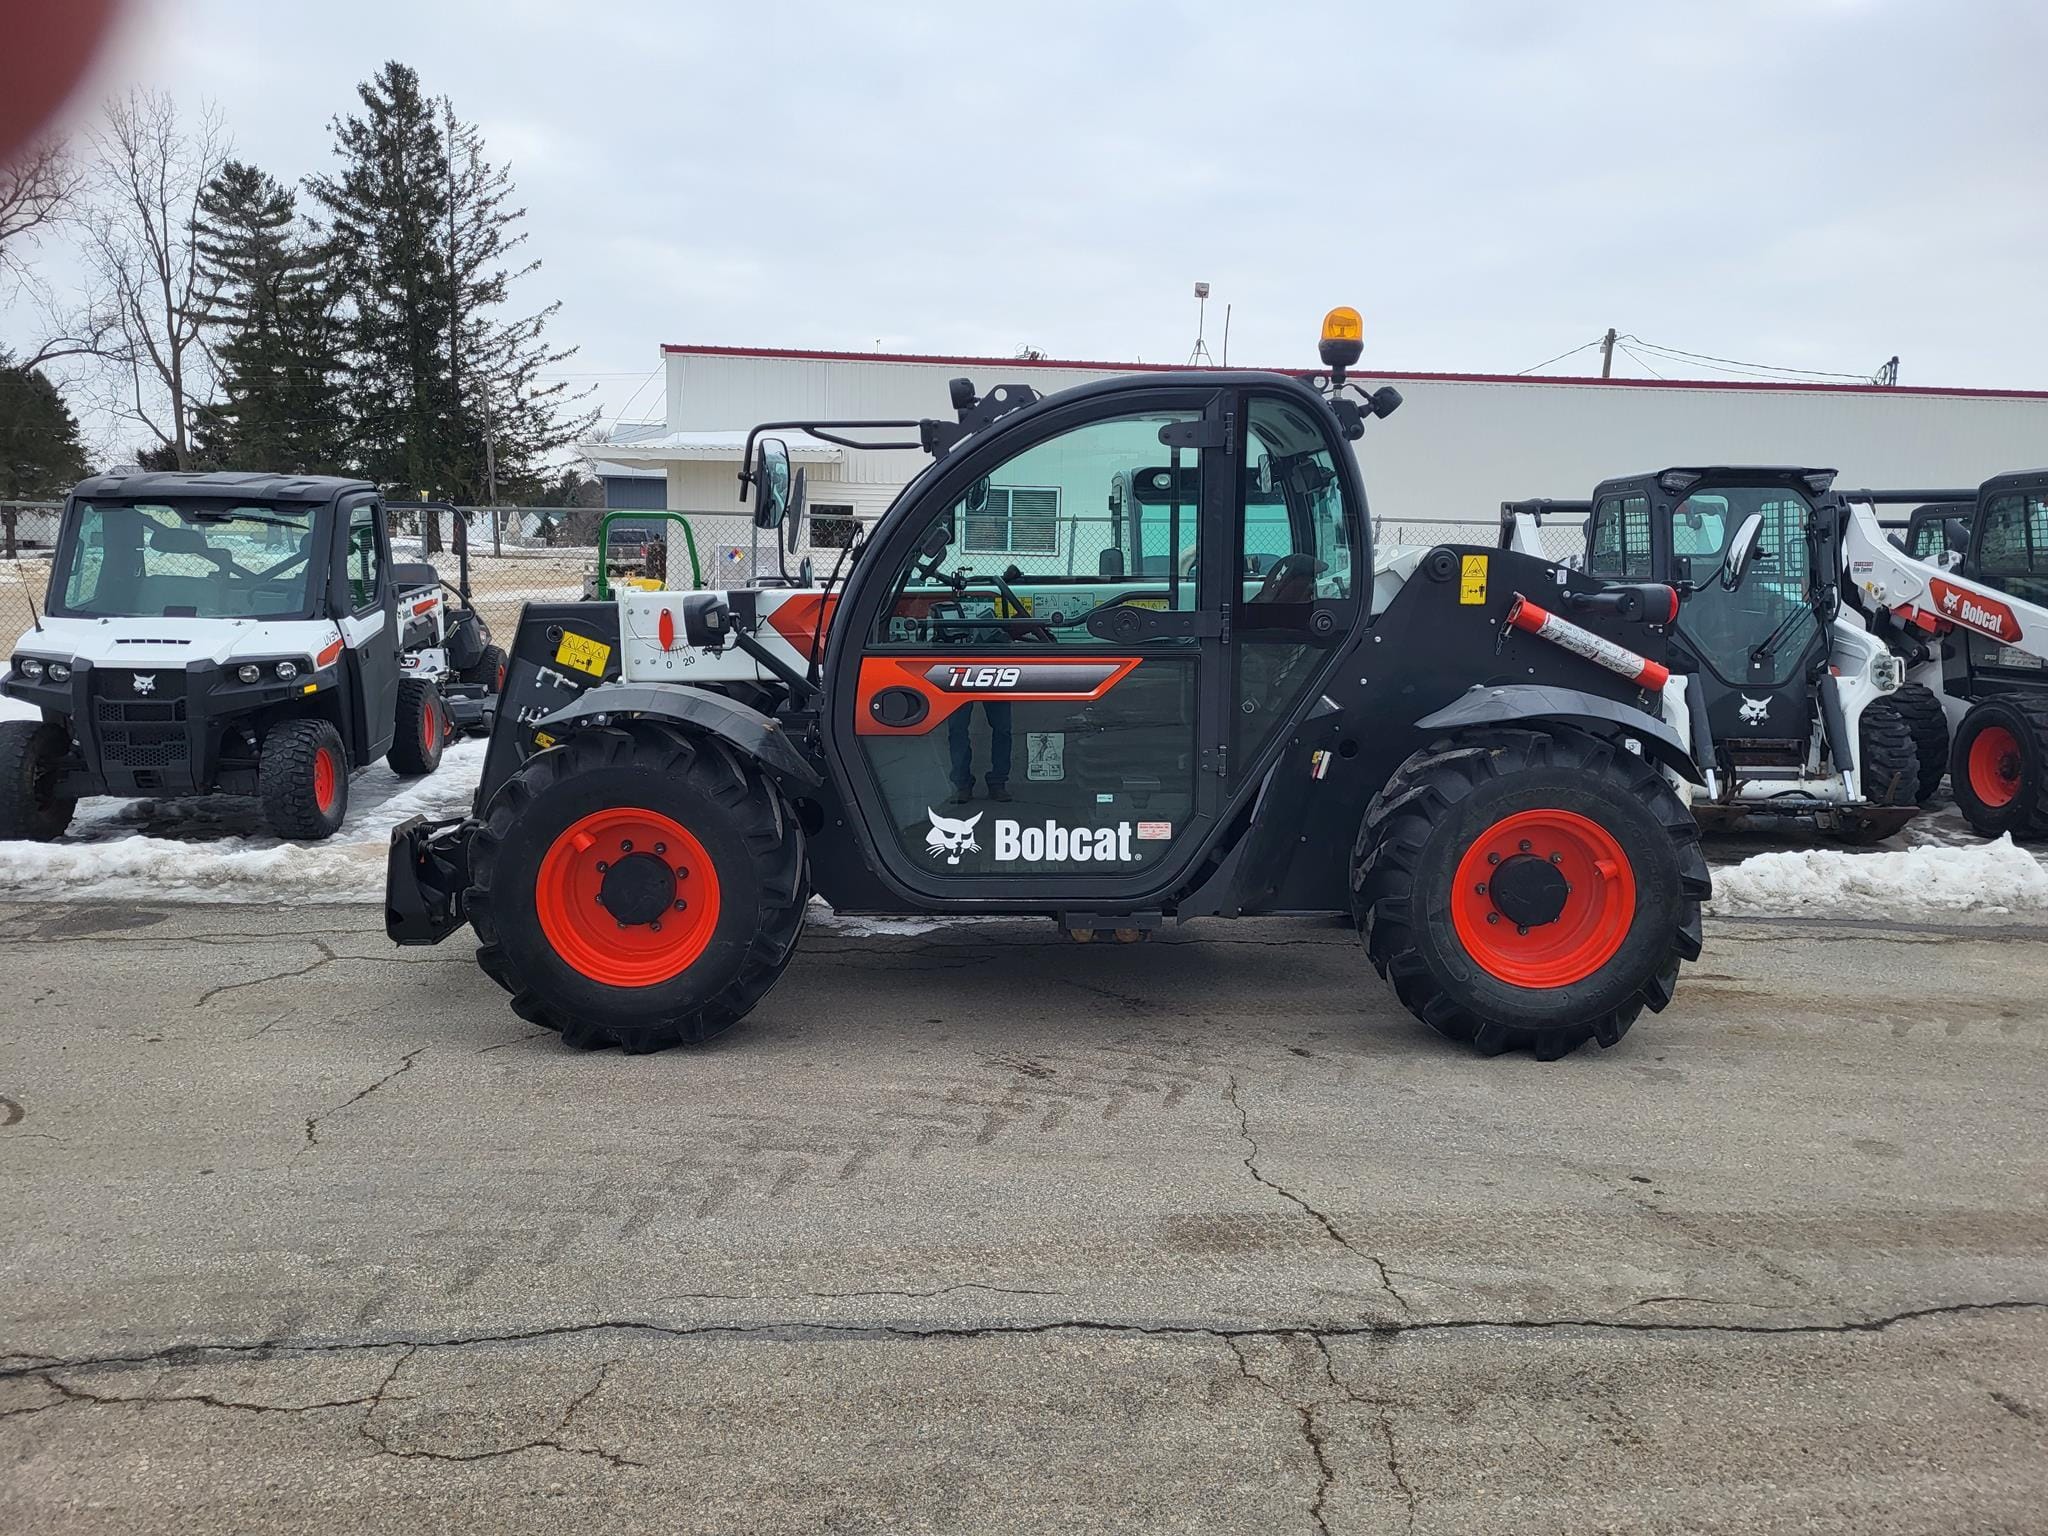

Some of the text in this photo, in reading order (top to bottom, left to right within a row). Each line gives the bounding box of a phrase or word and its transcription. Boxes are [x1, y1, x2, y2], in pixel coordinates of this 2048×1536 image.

[1961, 600, 2003, 633] Bobcat
[666, 655, 696, 669] 0 20
[949, 667, 1021, 687] TL619
[995, 819, 1132, 862] Bobcat
